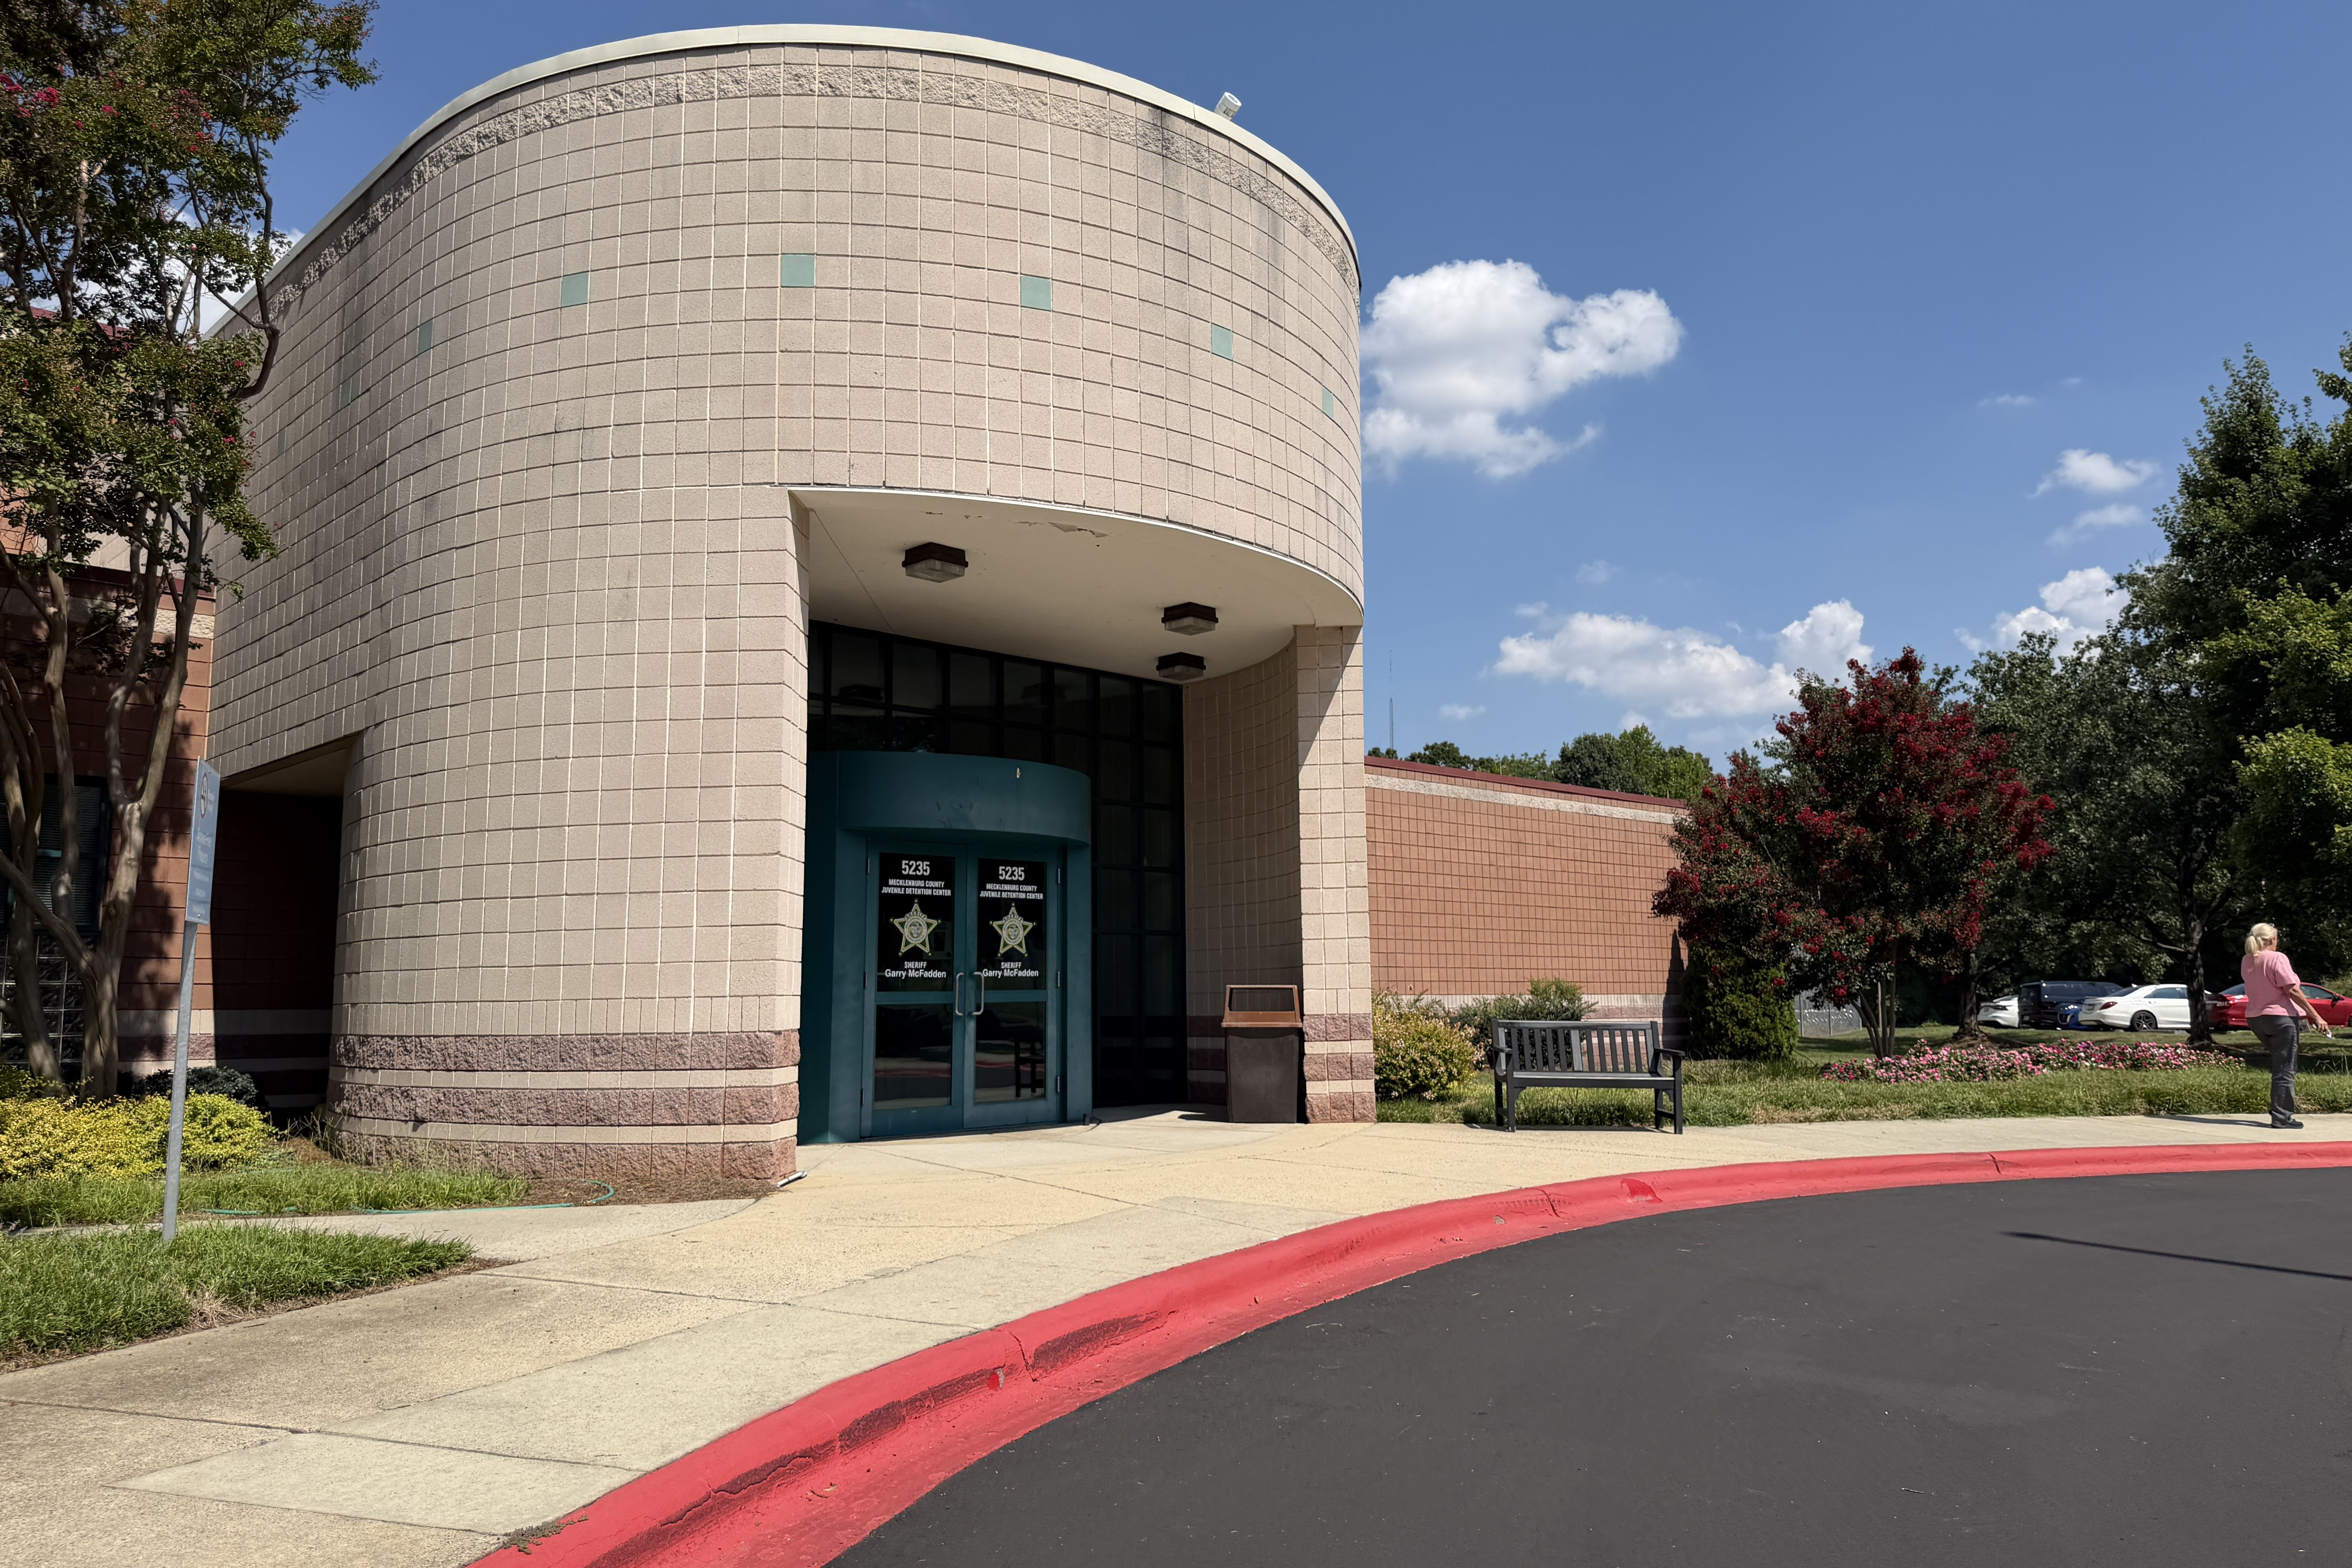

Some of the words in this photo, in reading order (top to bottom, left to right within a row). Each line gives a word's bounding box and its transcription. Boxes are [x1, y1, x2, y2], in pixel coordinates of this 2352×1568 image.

[902, 860, 930, 876] 5235
[999, 866, 1025, 881] 5235
[885, 969, 907, 979] Garry
[908, 969, 946, 978] McFadden
[983, 968, 1002, 979] Garry
